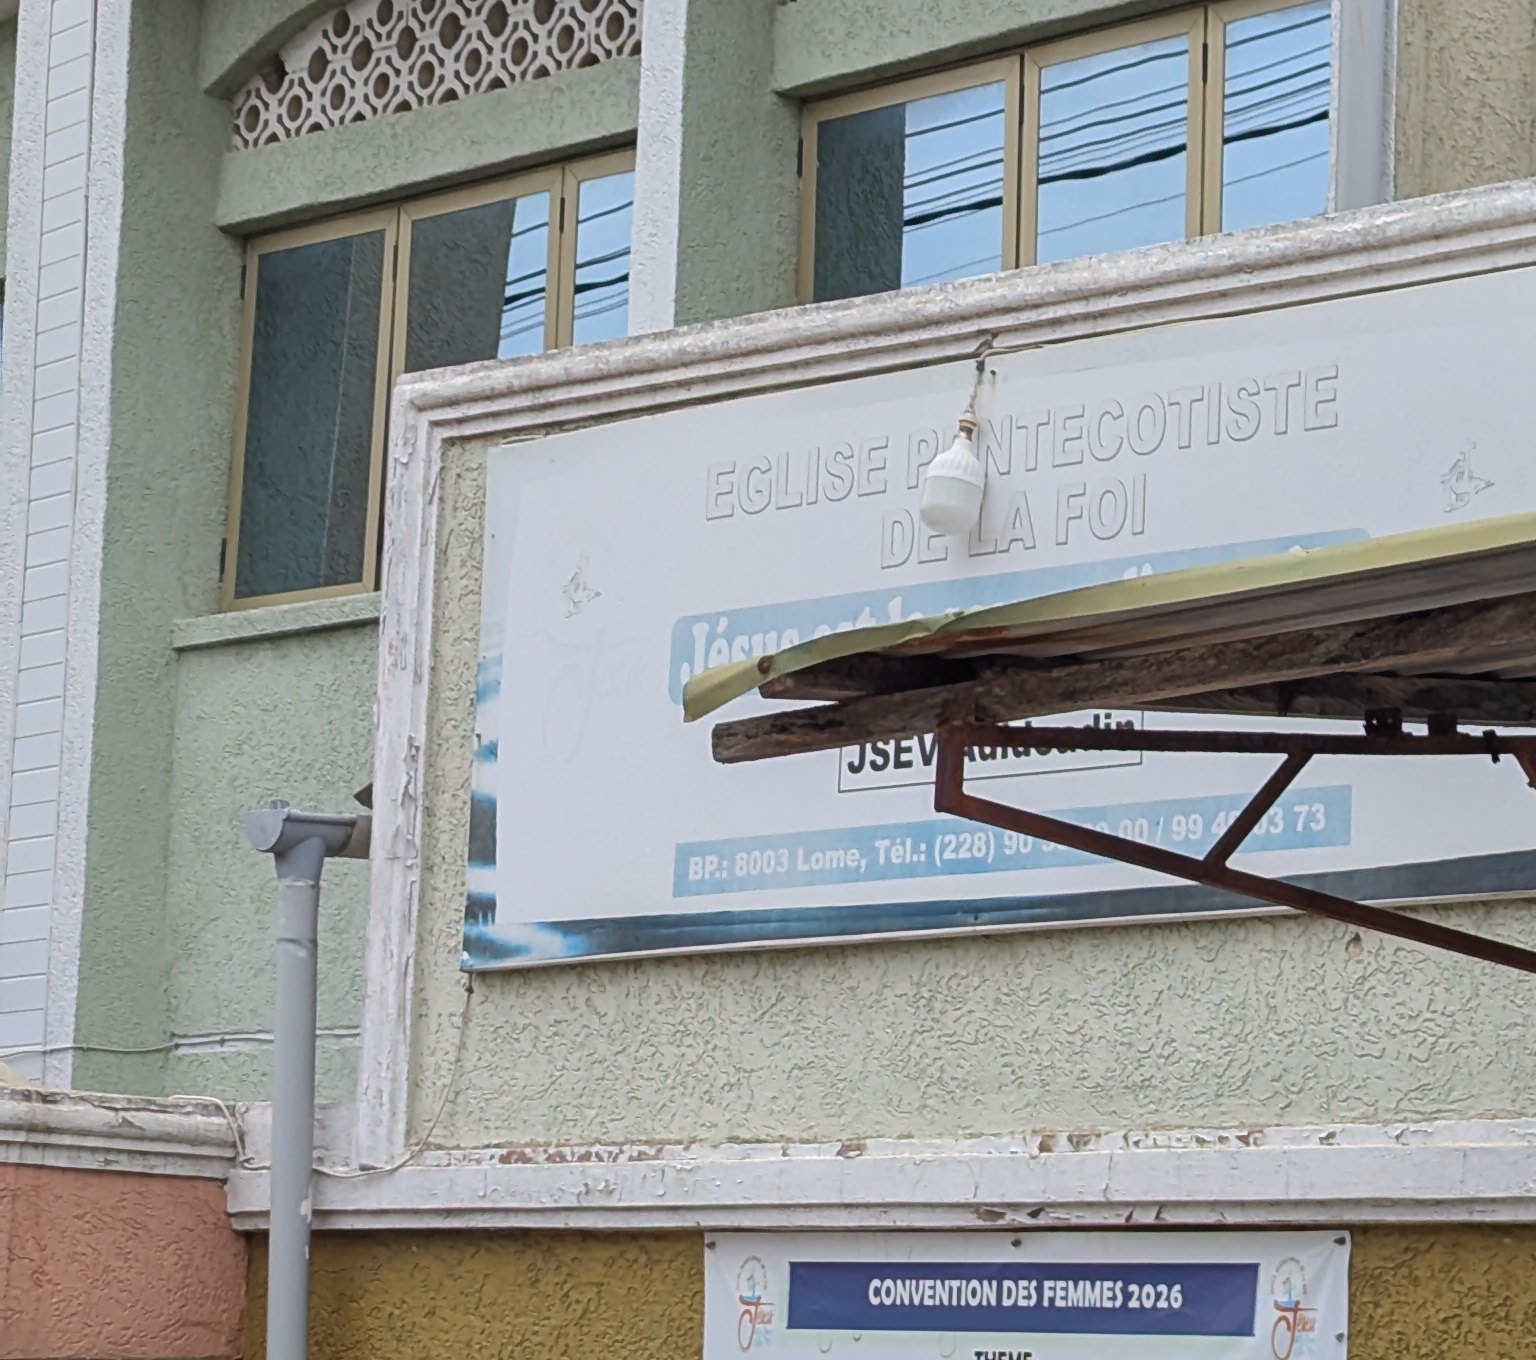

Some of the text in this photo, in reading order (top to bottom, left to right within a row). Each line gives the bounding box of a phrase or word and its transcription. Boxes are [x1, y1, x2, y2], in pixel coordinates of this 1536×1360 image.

[705, 363, 1339, 522] EGLISE PNTECOTISTE
[1054, 472, 1147, 546] FOI
[735, 847, 789, 878] 8003
[797, 843, 867, 872] Lome,
[934, 830, 995, 868] (228)
[1172, 813, 1203, 841] 99
[1294, 802, 1326, 832] 73
[868, 1278, 1183, 1309] CONVENTION DES FEMMES 2026
